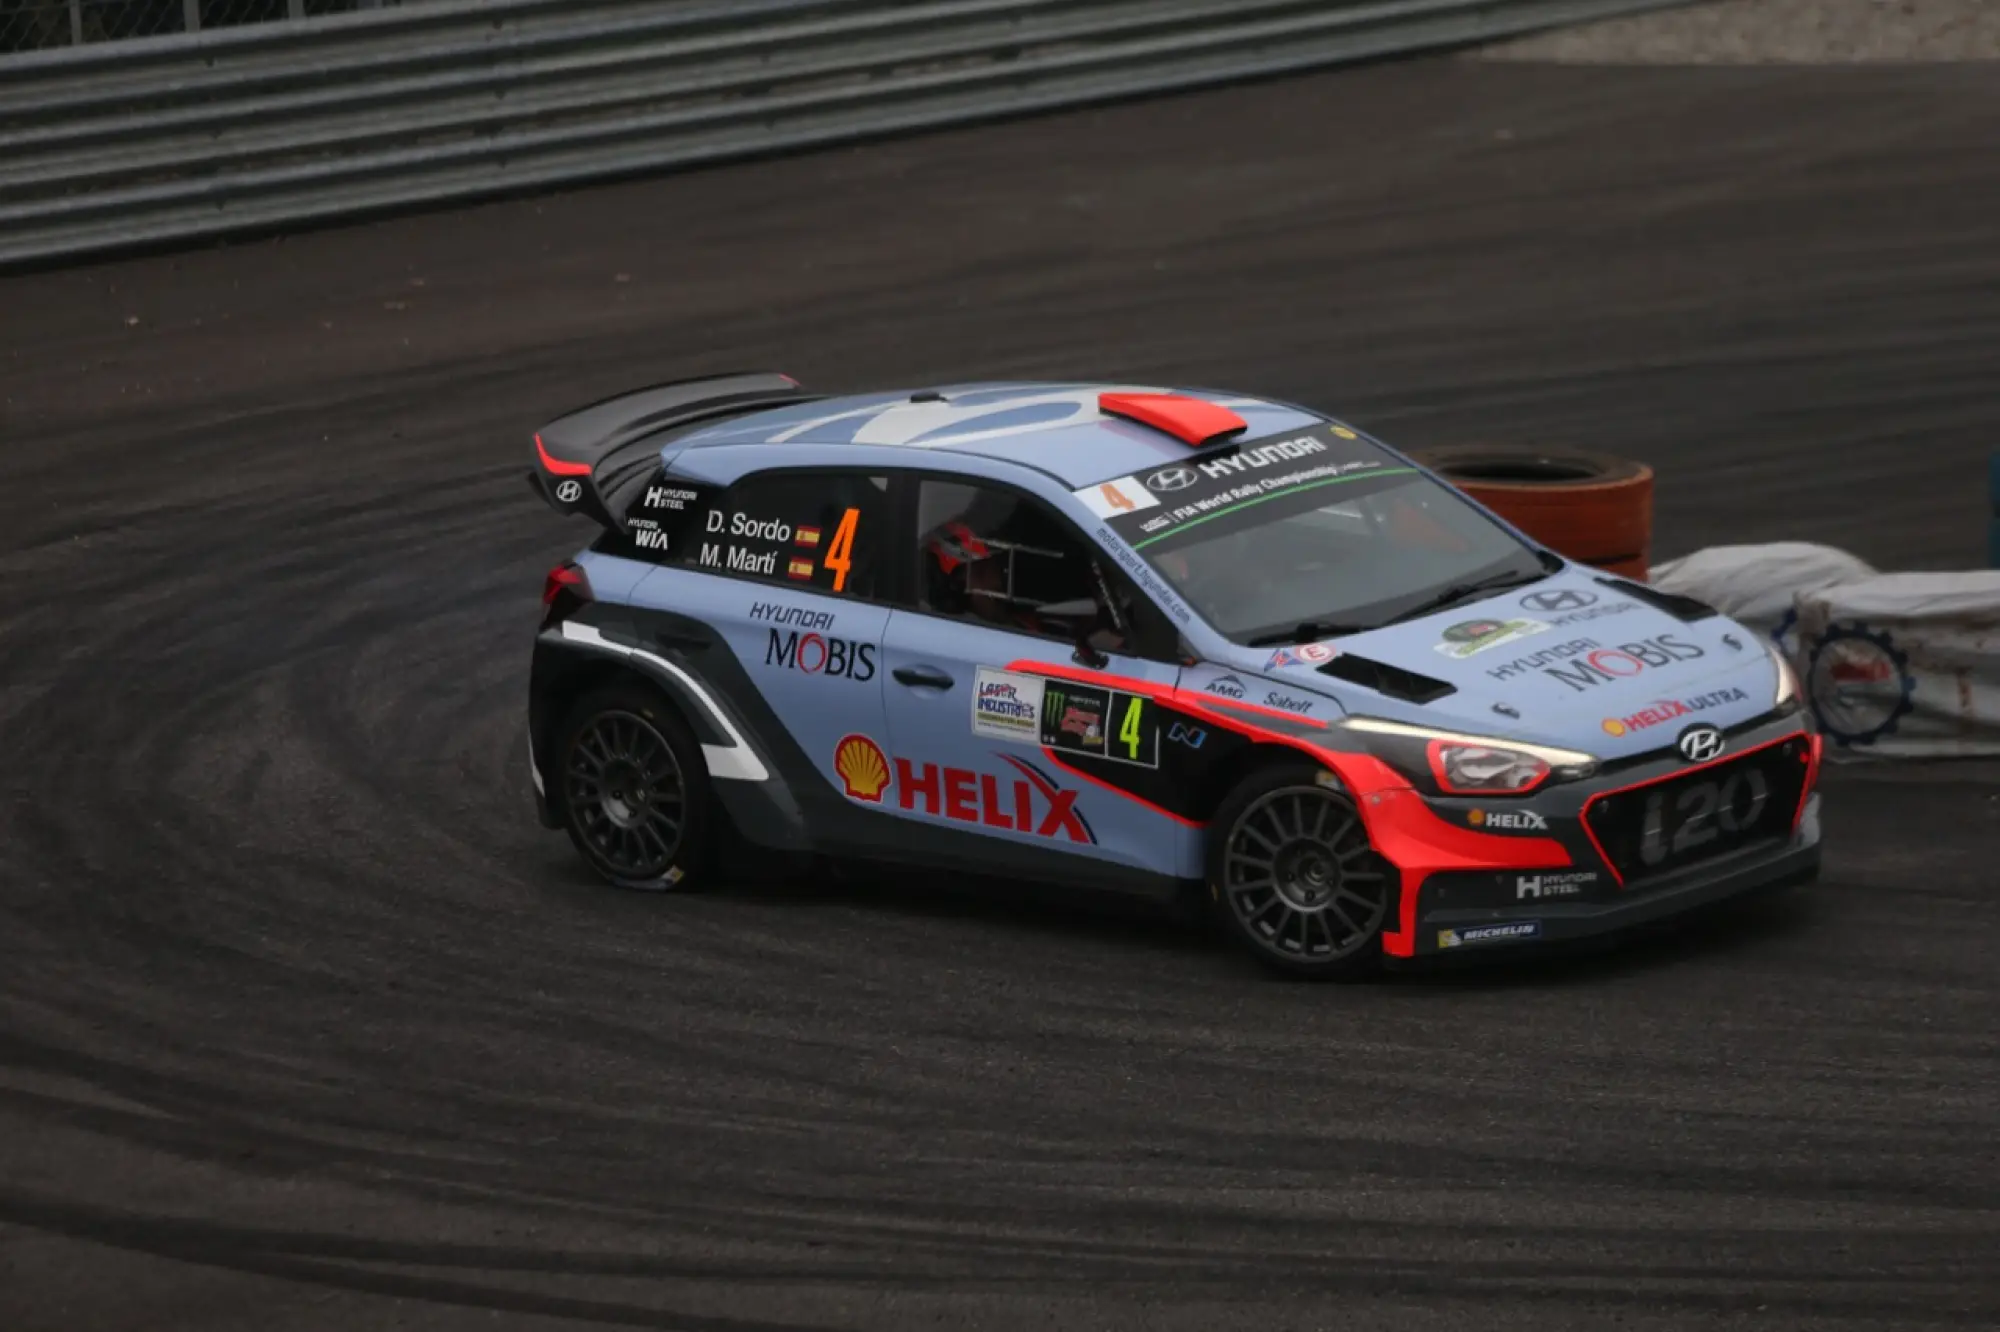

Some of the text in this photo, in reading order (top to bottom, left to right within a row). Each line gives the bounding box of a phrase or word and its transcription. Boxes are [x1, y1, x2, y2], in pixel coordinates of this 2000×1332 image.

[1197, 436, 1329, 478] HYUNDAI
[644, 486, 662, 508] H
[1100, 483, 1136, 512] 4
[1194, 491, 1233, 511] World
[1229, 484, 1264, 499] Rally
[706, 509, 790, 542] D. Sordo
[700, 542, 778, 574] M. Martí
[824, 507, 860, 592] 4
[750, 601, 836, 630] HYUNDAI
[766, 627, 876, 682] MOBIS
[1306, 645, 1326, 658] E
[1485, 636, 1602, 681] HYUNDAI
[1540, 633, 1706, 693] MOBIS
[1622, 686, 1749, 732] HELIX ULTRA
[1119, 695, 1143, 760] 4
[893, 750, 1098, 845] HELIX
[1486, 808, 1549, 830] HELIX
[1516, 875, 1541, 899] H
[1463, 924, 1535, 939] MICHELIN
